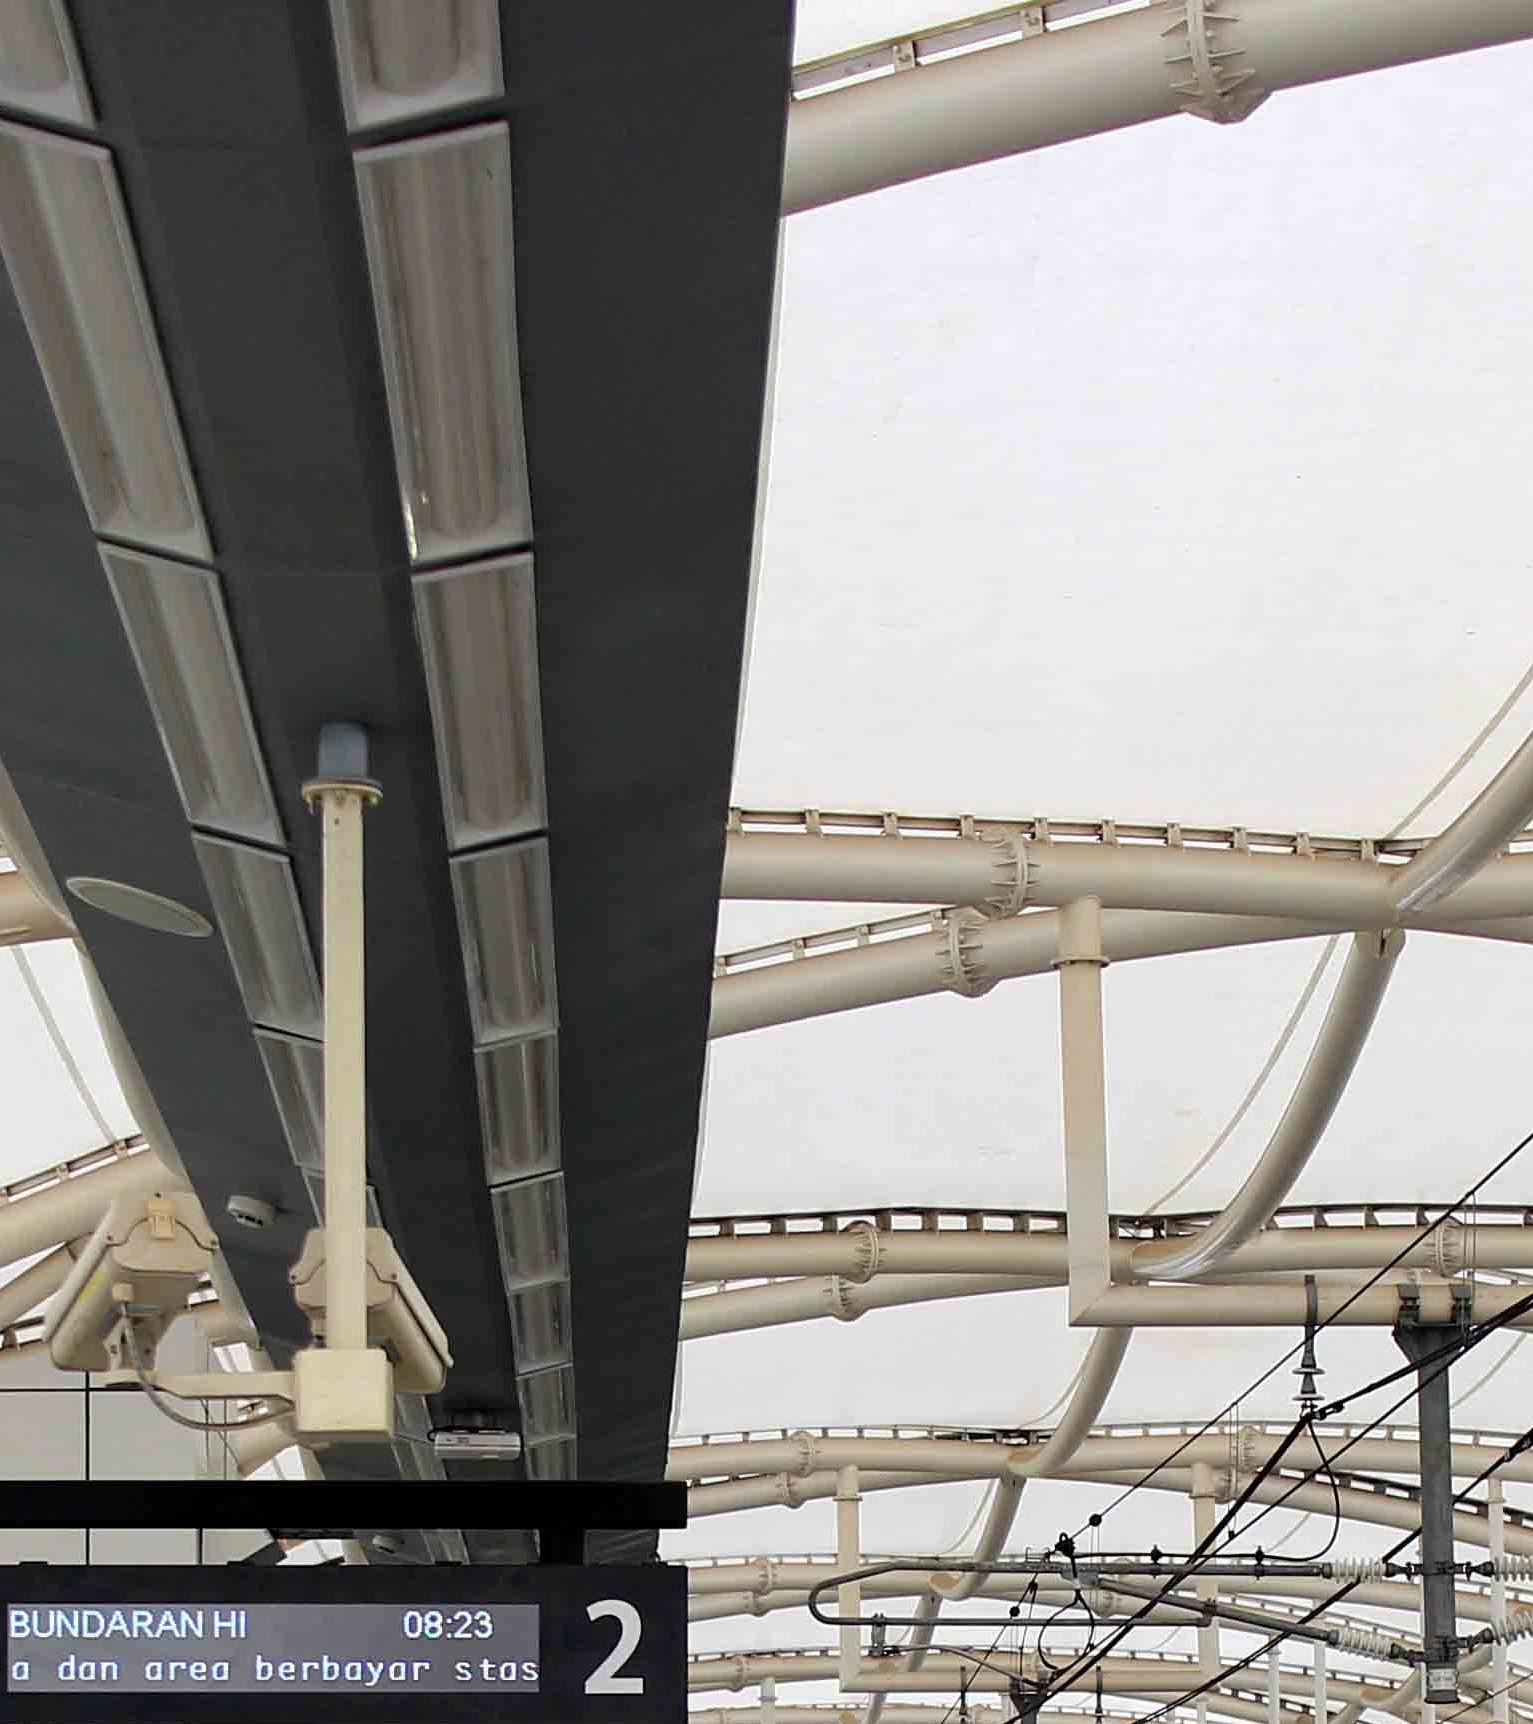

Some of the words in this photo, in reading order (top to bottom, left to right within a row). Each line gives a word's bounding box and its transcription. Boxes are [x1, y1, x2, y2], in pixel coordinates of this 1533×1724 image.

[9, 1609, 204, 1639] BUNDARAN
[213, 1609, 247, 1639] HI
[402, 1610, 494, 1639] 08:23
[583, 1598, 645, 1695] 2
[58, 1653, 119, 1681] dan
[144, 1660, 230, 1681] area
[254, 1655, 431, 1687] berbayar
[454, 1657, 540, 1682] stas
